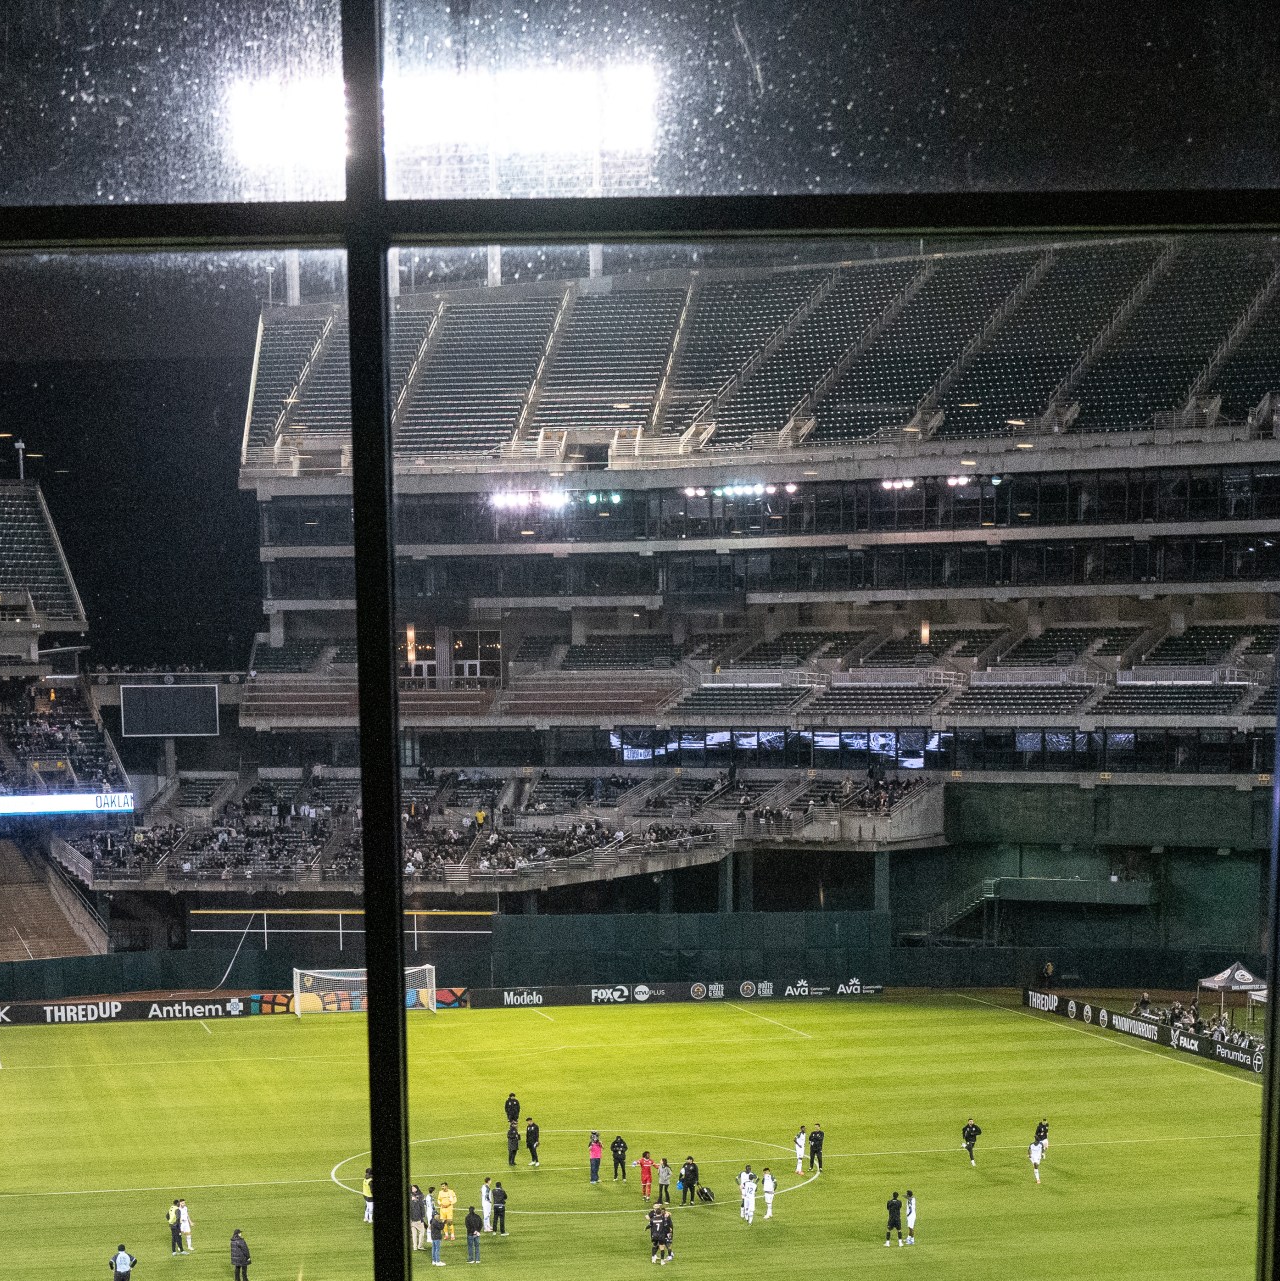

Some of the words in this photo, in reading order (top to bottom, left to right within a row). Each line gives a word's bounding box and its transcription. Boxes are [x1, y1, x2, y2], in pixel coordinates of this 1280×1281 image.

[591, 988, 614, 999] FOX
[785, 986, 809, 996] Ava
[837, 984, 860, 994] Ava
[503, 990, 543, 1005] Modelo
[1028, 990, 1059, 1012] THREDUP
[43, 1001, 122, 1023] THREDUP
[148, 1002, 223, 1019] Anthem
[1112, 1014, 1158, 1041] #KNOWYOURROOTS
[1179, 1036, 1199, 1052] FALCK
[1216, 1044, 1251, 1064] Penumbra
